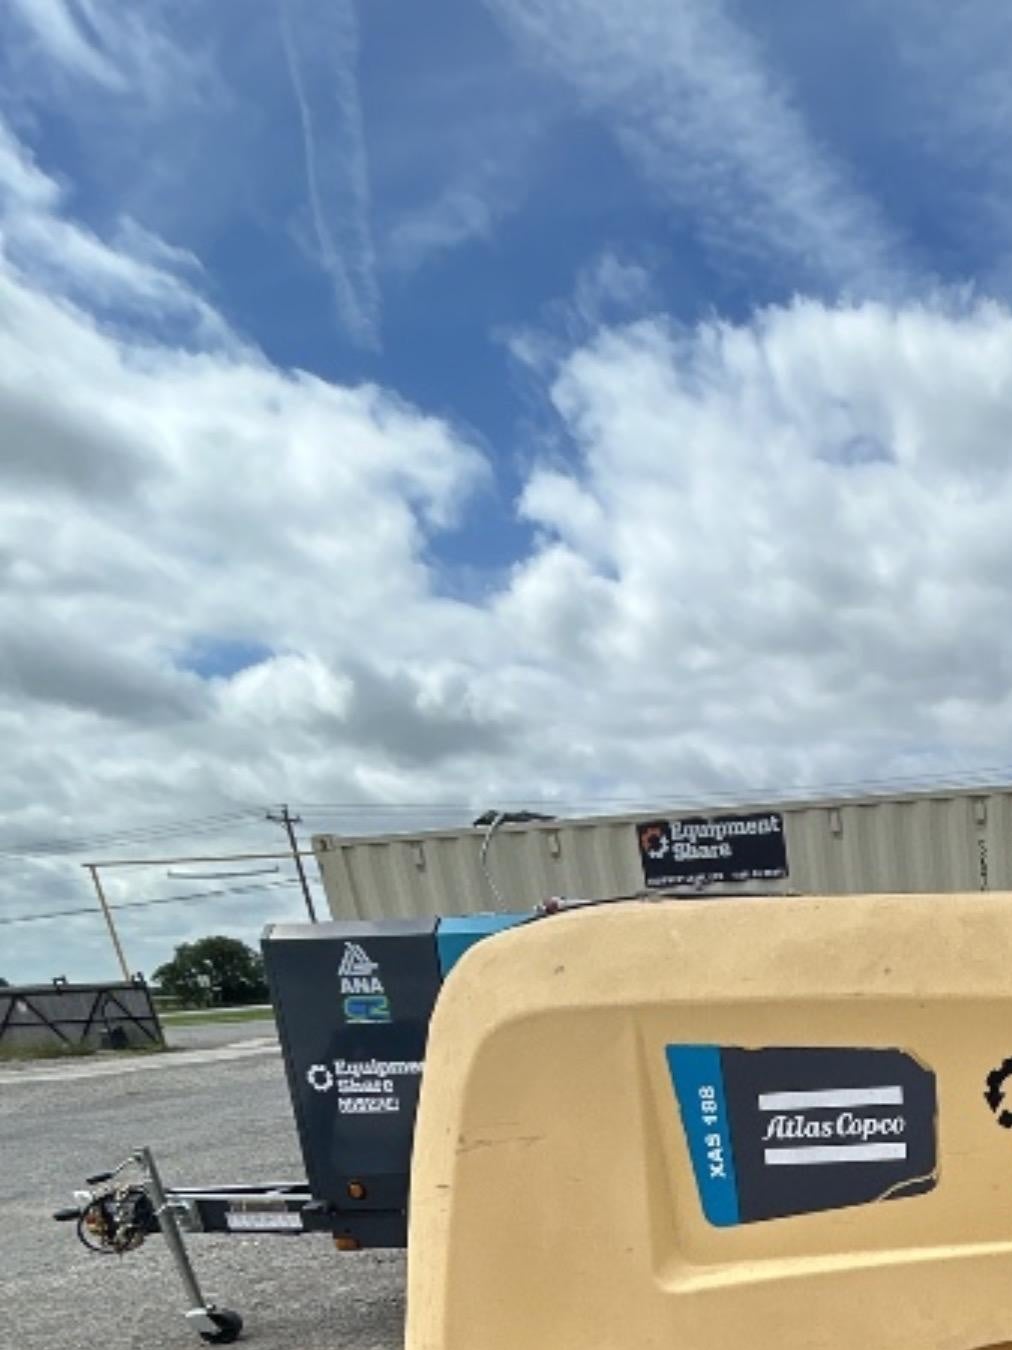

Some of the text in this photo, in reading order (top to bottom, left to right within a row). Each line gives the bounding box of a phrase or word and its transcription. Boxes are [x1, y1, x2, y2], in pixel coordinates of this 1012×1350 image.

[670, 816, 781, 842] Equipment
[672, 842, 733, 861] Share
[698, 1085, 726, 1178] XAS 188
[761, 1112, 906, 1141] Atlas Copco
